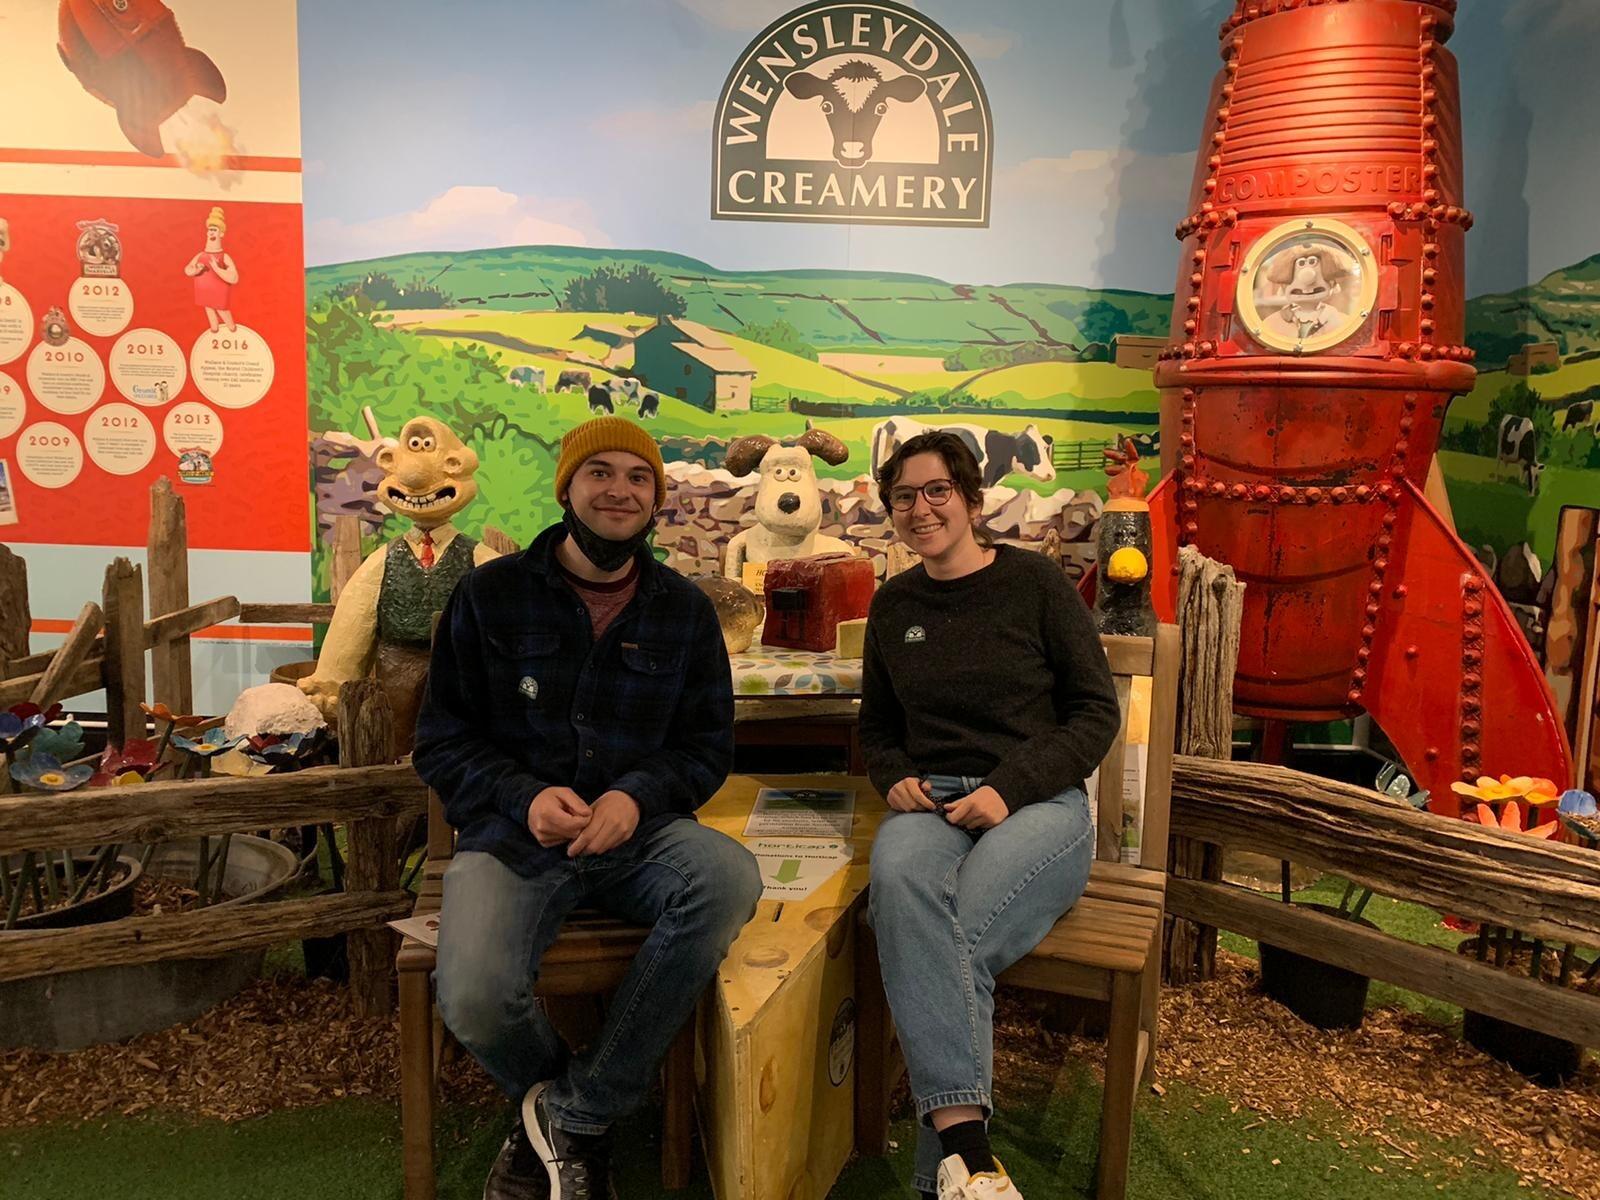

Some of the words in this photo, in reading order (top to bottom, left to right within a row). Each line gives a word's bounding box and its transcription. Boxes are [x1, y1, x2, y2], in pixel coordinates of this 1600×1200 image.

[725, 13, 979, 152] WENSLEYDALE
[727, 169, 978, 210] CREAMERY
[1218, 165, 1421, 204] COMPOSTER
[82, 285, 120, 297] 2012
[127, 344, 164, 355] 2013
[211, 339, 249, 350] 2016
[44, 351, 85, 363] 2010
[102, 416, 138, 428] 2012
[174, 414, 210, 425] 2013
[29, 435, 70, 447] 2009
